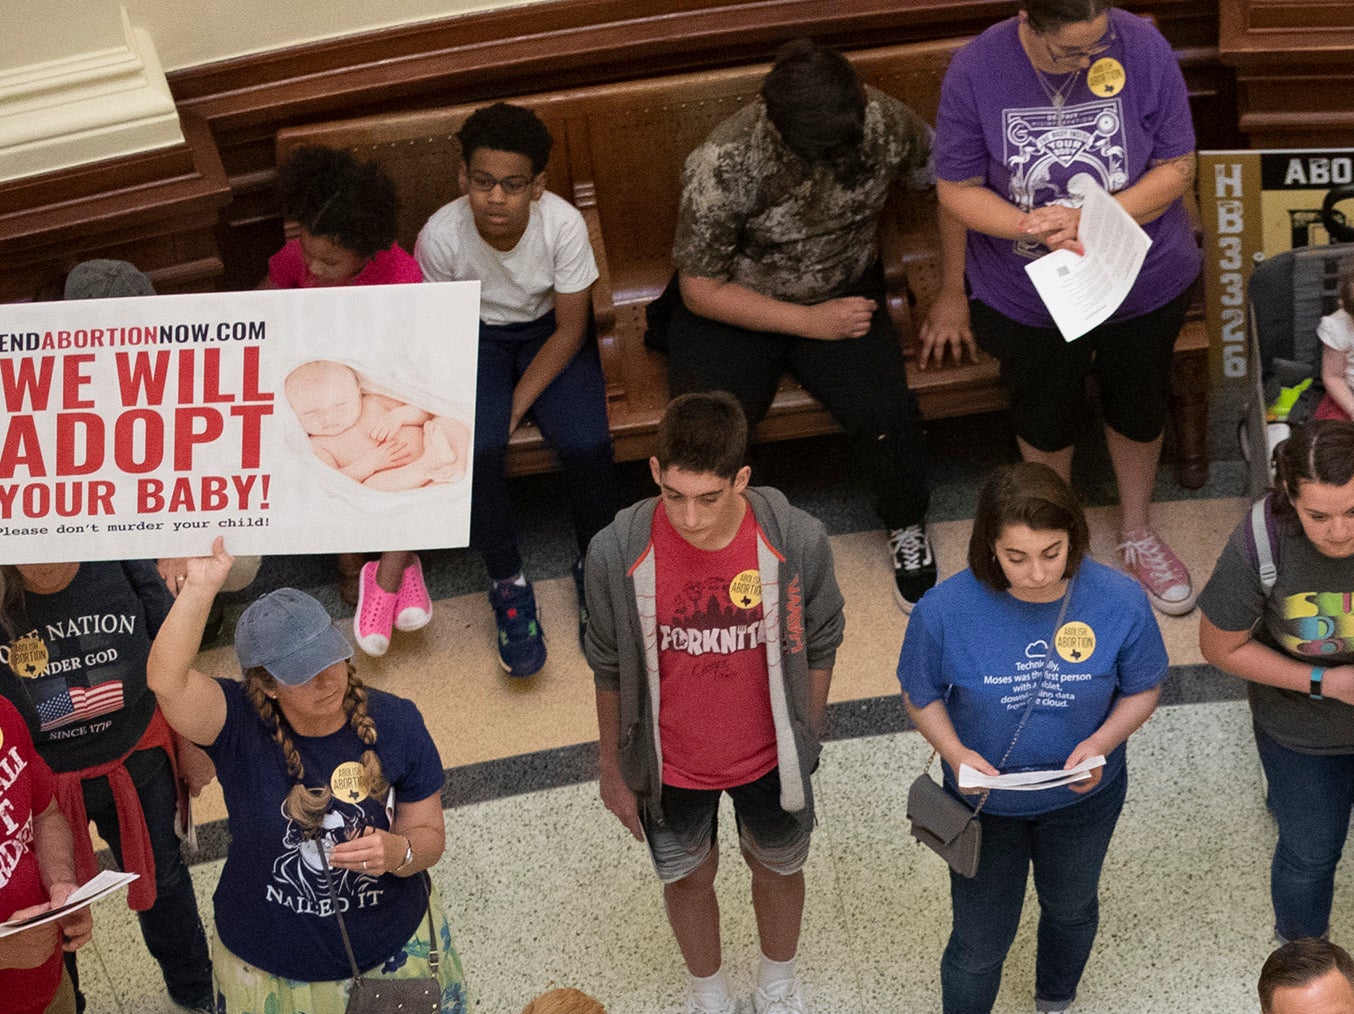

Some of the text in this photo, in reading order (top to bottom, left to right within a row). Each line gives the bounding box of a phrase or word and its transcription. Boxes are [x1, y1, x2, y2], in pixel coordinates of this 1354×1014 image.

[0, 321, 266, 353] ENDABORTIONNOW.COM
[0, 346, 275, 413] WE WILL
[0, 404, 274, 479] ADOPT
[0, 474, 271, 519] YOUR BABY!
[107, 521, 164, 532] murder
[173, 519, 210, 532] your
[218, 517, 270, 529] child!
[46, 614, 136, 641] NATION
[31, 648, 118, 680] NDER GOD
[984, 675, 1012, 685] Moses
[1013, 674, 1031, 682] was
[1060, 673, 1092, 683] person
[49, 726, 87, 740] SINCE
[357, 890, 384, 909] IT
